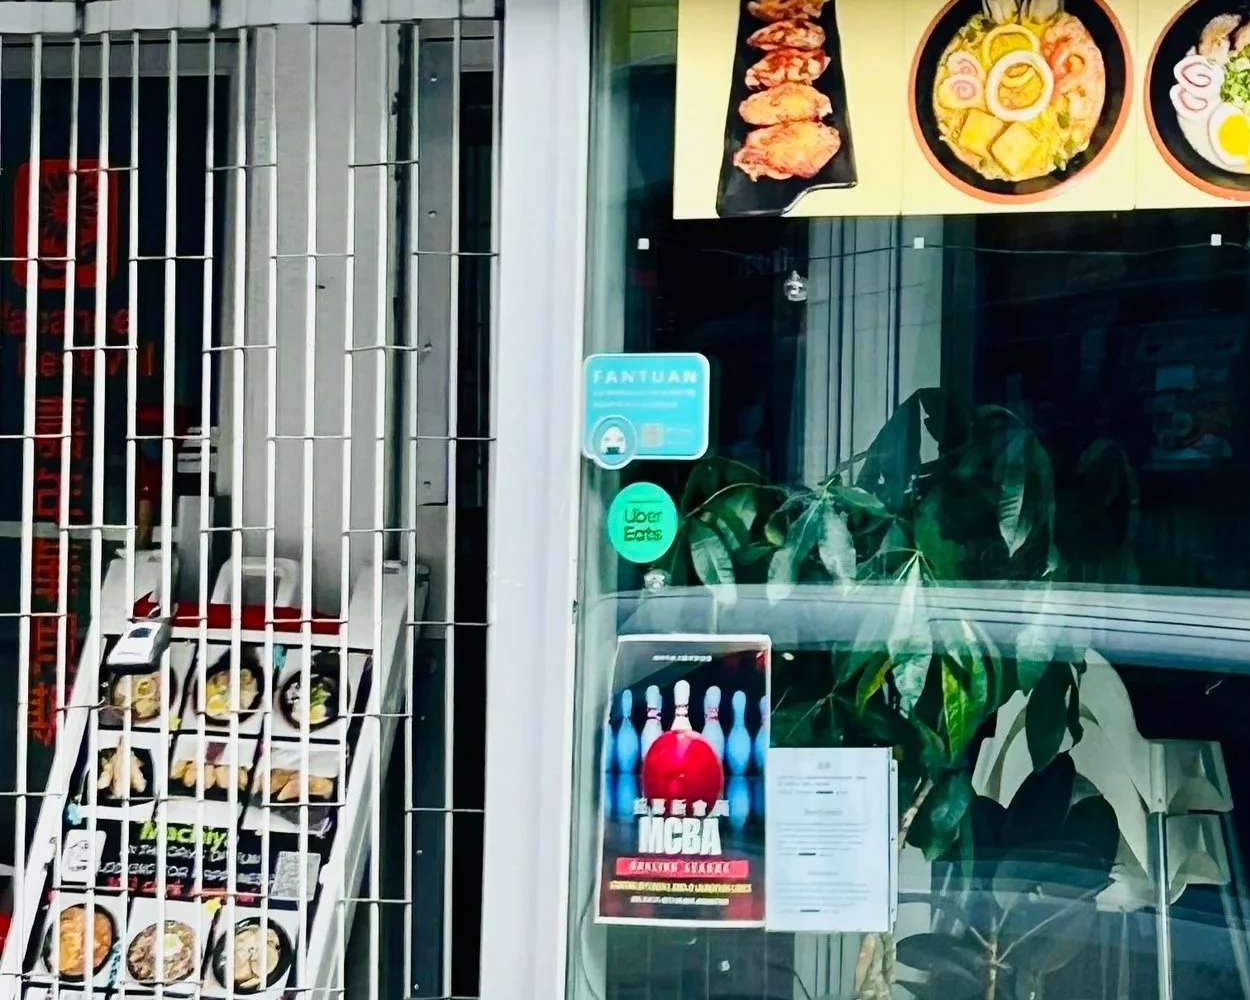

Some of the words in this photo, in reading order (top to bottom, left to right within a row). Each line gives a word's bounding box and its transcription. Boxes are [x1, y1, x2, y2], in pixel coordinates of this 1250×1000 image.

[592, 369, 698, 384] FANTUAN
[624, 508, 663, 523] Uber
[623, 526, 663, 542] Eats
[638, 816, 722, 855] MCBA
